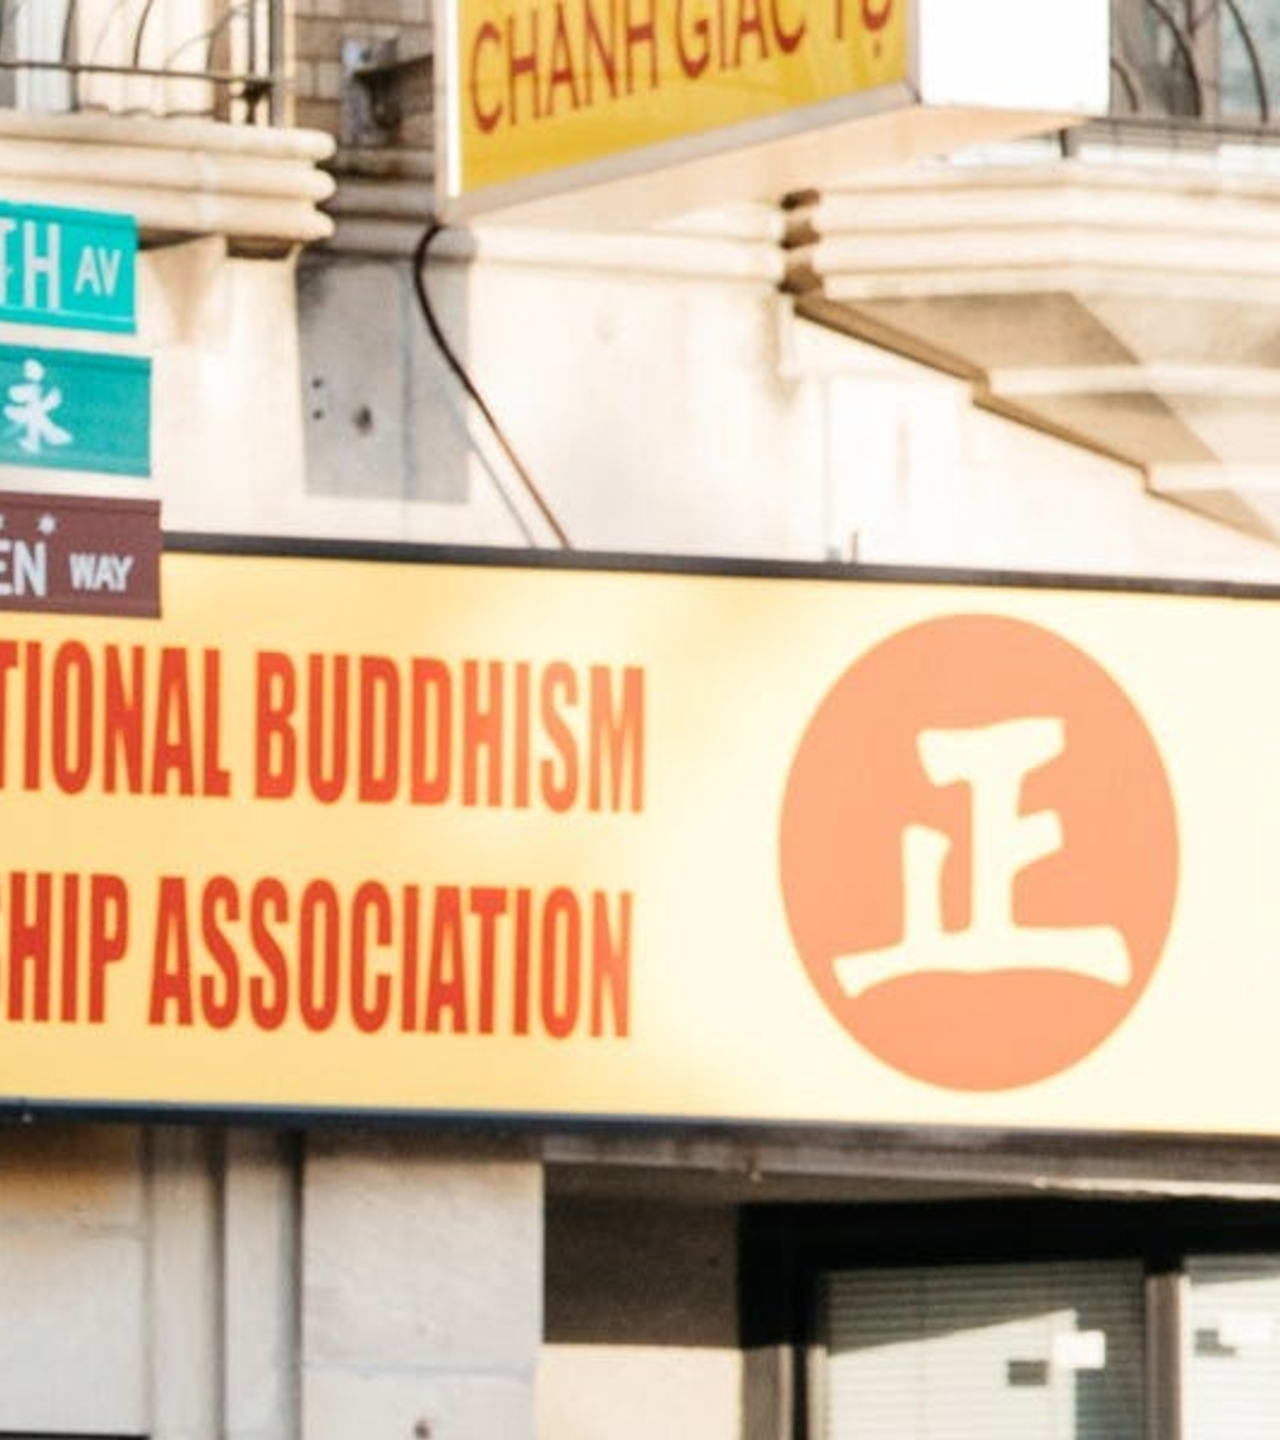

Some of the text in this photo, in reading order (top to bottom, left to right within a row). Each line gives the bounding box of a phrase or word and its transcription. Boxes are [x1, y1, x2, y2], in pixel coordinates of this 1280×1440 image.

[74, 245, 122, 297] AV
[69, 552, 135, 593] WAY
[253, 649, 647, 815] BUDDHISM
[831, 715, 1133, 1000] 正
[147, 874, 634, 1040] ASSOCIATION
